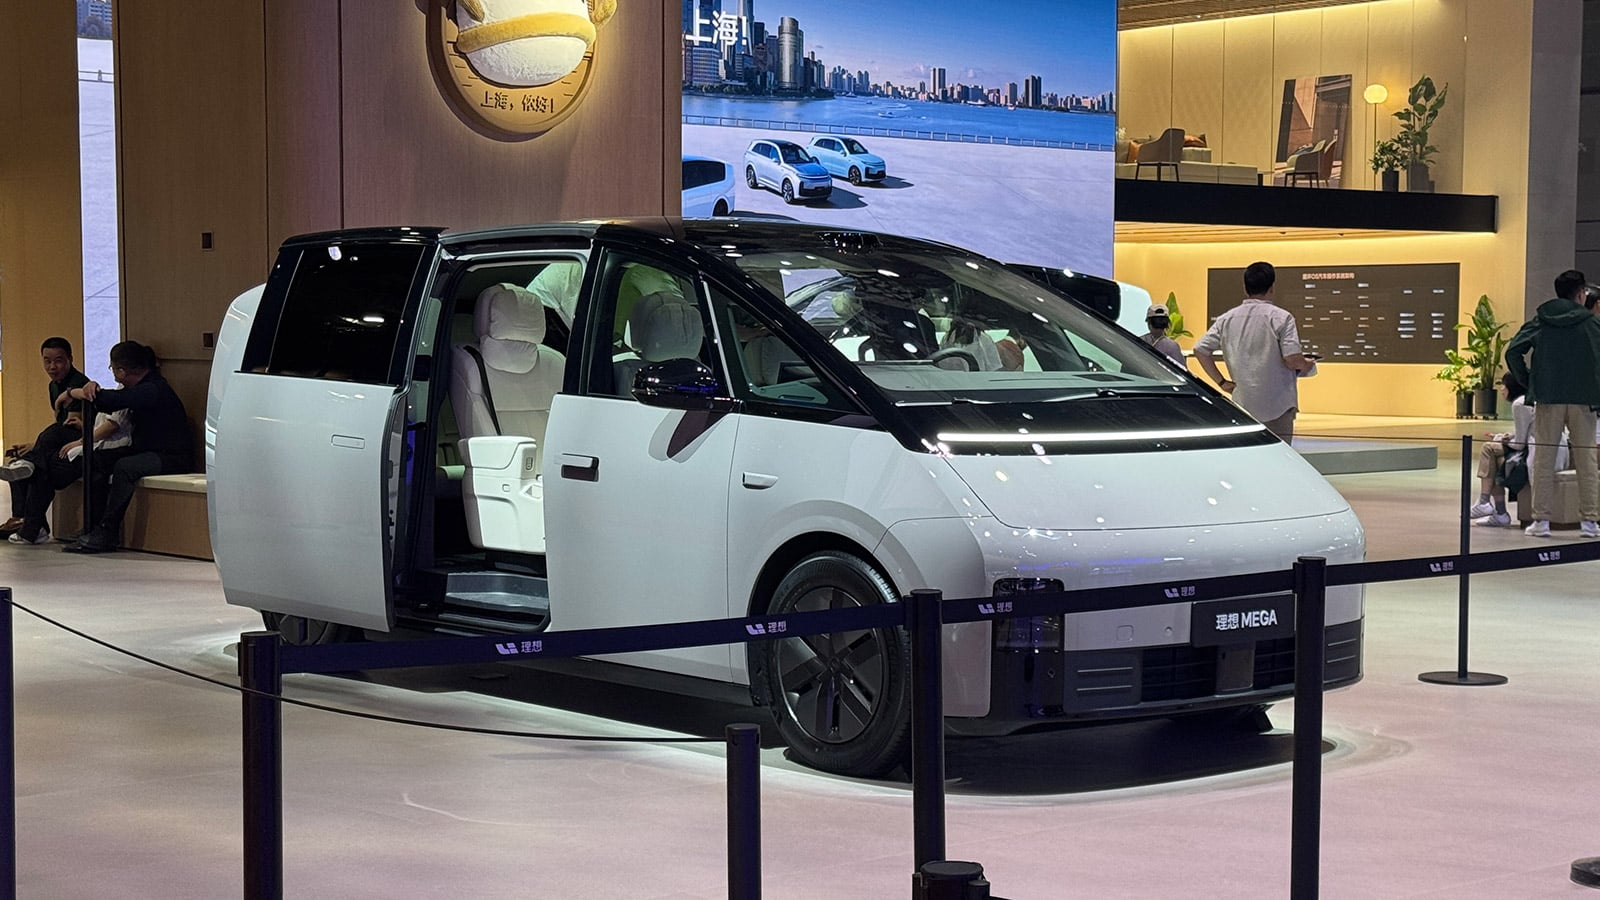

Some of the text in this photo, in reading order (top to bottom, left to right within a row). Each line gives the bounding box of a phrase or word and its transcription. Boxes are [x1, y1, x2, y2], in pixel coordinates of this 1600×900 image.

[767, 620, 787, 634] 理想
[1215, 609, 1278, 631] 理想 MEGA
[520, 640, 543, 654] 理想
